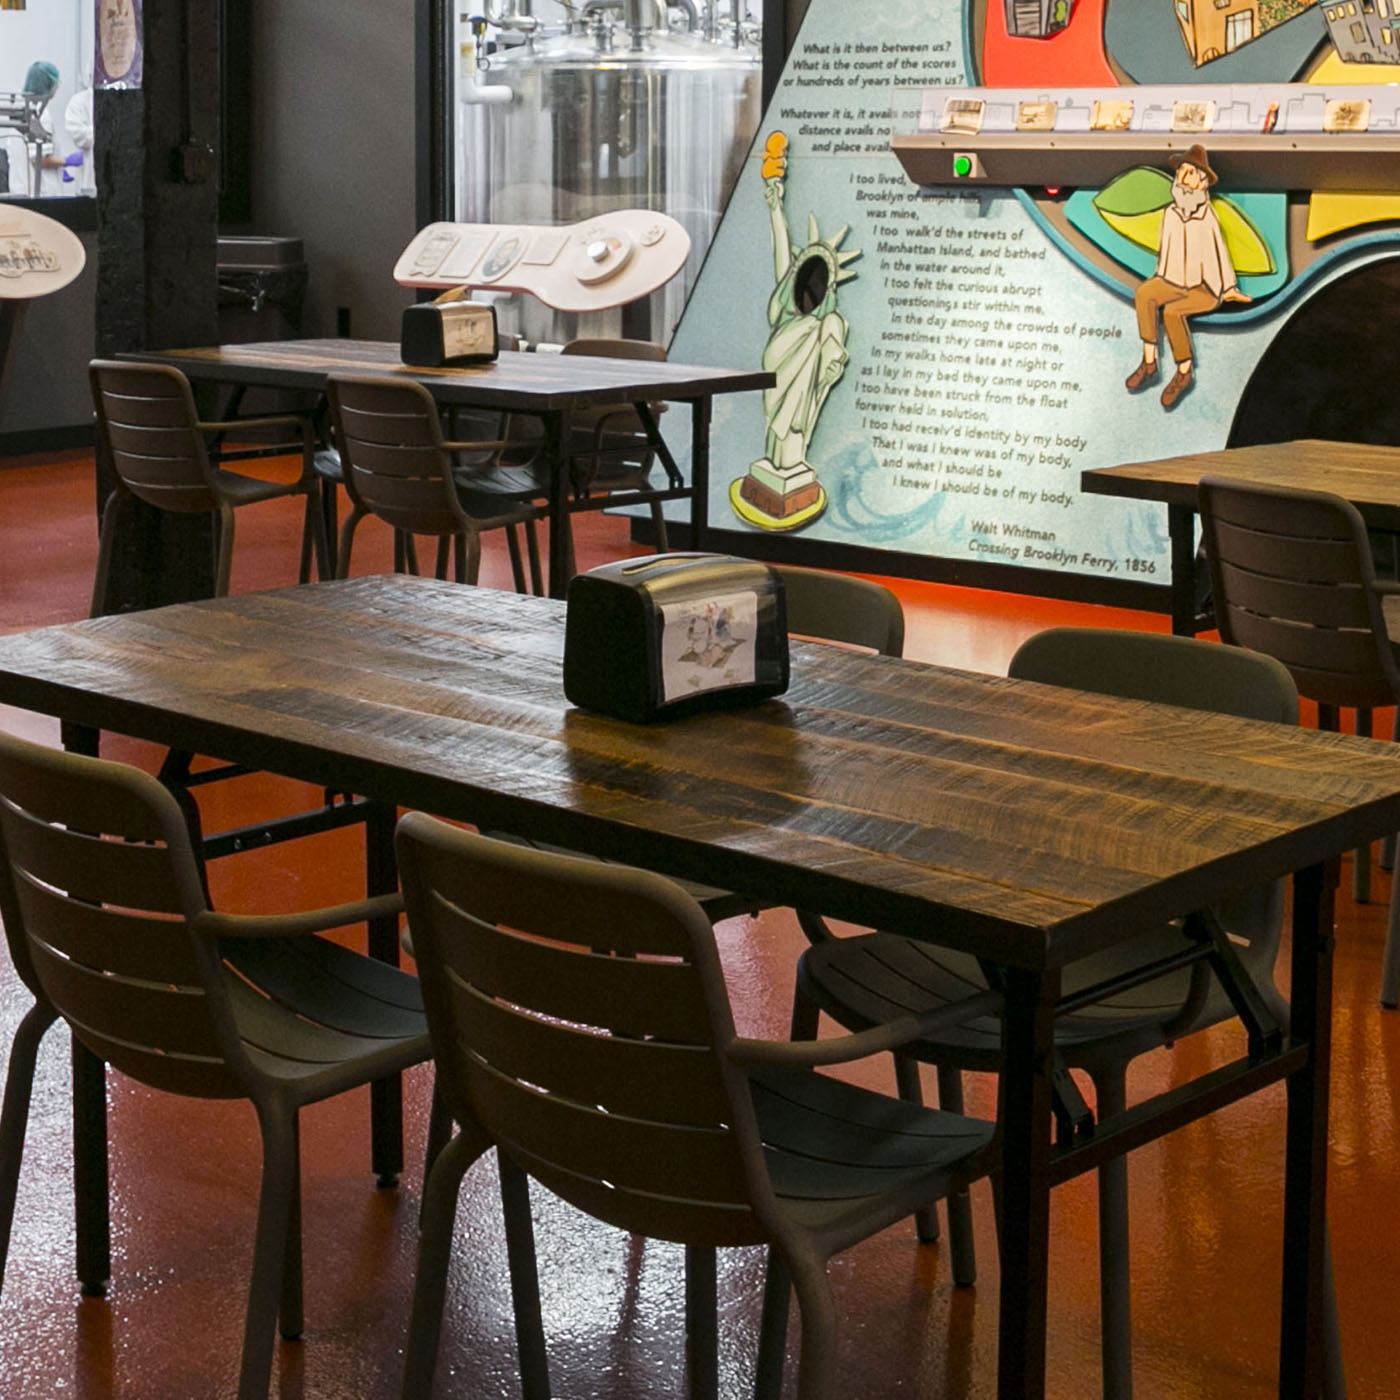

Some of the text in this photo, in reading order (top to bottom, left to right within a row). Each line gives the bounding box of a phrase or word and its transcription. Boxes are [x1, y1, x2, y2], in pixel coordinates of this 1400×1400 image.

[803, 43, 830, 53] What
[832, 42, 840, 53] is
[843, 43, 851, 53] it
[854, 42, 878, 53] then
[881, 42, 928, 52] between
[793, 57, 956, 70] What is the count of the scores
[796, 75, 844, 86] hundreds
[847, 74, 859, 85] of
[860, 77, 890, 88] years
[893, 75, 941, 85] between
[780, 107, 829, 118] Whatever
[832, 108, 840, 118] it
[857, 108, 866, 118] it
[798, 124, 873, 135] distance avails
[811, 141, 861, 153] and place
[856, 174, 874, 184] too
[855, 189, 920, 204] Brooklyn of
[866, 210, 886, 218] was
[879, 225, 1024, 240] too walk'd the streets of
[876, 241, 935, 254] Manhattan
[979, 247, 1000, 257] and
[1004, 246, 1046, 260] bathed
[893, 259, 911, 271] the
[915, 263, 947, 272] water
[950, 264, 991, 275] around
[891, 278, 910, 288] too
[913, 277, 932, 289] felt
[936, 279, 953, 290] the
[1002, 283, 1042, 297] abrupt
[962, 300, 981, 310] stir
[984, 301, 1019, 311] within
[905, 313, 922, 324] the
[926, 314, 947, 329] day
[950, 319, 989, 332] among
[993, 319, 1012, 330] the
[1016, 321, 1058, 333] crowds
[1063, 322, 1076, 334] of
[1078, 325, 1122, 340] people
[881, 331, 940, 344] sometimes
[945, 334, 970, 348] they
[974, 338, 1003, 348] came
[1007, 341, 1037, 351] upon
[884, 349, 901, 362] my
[905, 349, 935, 361] walks
[939, 351, 970, 364] home
[975, 354, 996, 366] late
[1000, 357, 1012, 367] at
[1015, 358, 1046, 372] night
[1050, 361, 1064, 371] or
[860, 366, 872, 375] as
[883, 364, 899, 380] lay
[902, 367, 912, 377] in
[915, 370, 933, 383] my
[936, 369, 958, 382] bed
[962, 372, 988, 387] they
[991, 376, 1022, 386] came
[1026, 379, 1056, 390] upon
[861, 383, 1068, 408] too have been struck from the float
[855, 397, 895, 412] forever
[898, 403, 923, 415] held
[869, 419, 888, 429] too
[891, 419, 912, 432] had
[964, 427, 1010, 444] identity
[1014, 430, 1029, 446] by
[1033, 435, 1051, 448] my
[1055, 433, 1087, 452] body
[872, 435, 896, 449] That
[906, 443, 928, 452] was
[939, 442, 970, 456] knew
[974, 449, 996, 459] was
[1000, 448, 1014, 460] of
[1016, 452, 1034, 466] my
[881, 457, 1002, 478] and what should be
[899, 475, 930, 489] knew
[941, 481, 979, 495] should
[983, 484, 998, 496] be
[1002, 485, 1016, 498] of
[1018, 490, 1037, 504] my
[971, 521, 1055, 541] Walt Whitman
[968, 538, 1019, 558] Crossing
[1023, 545, 1077, 565] Brooklyn
[1124, 557, 1155, 573] 1856
